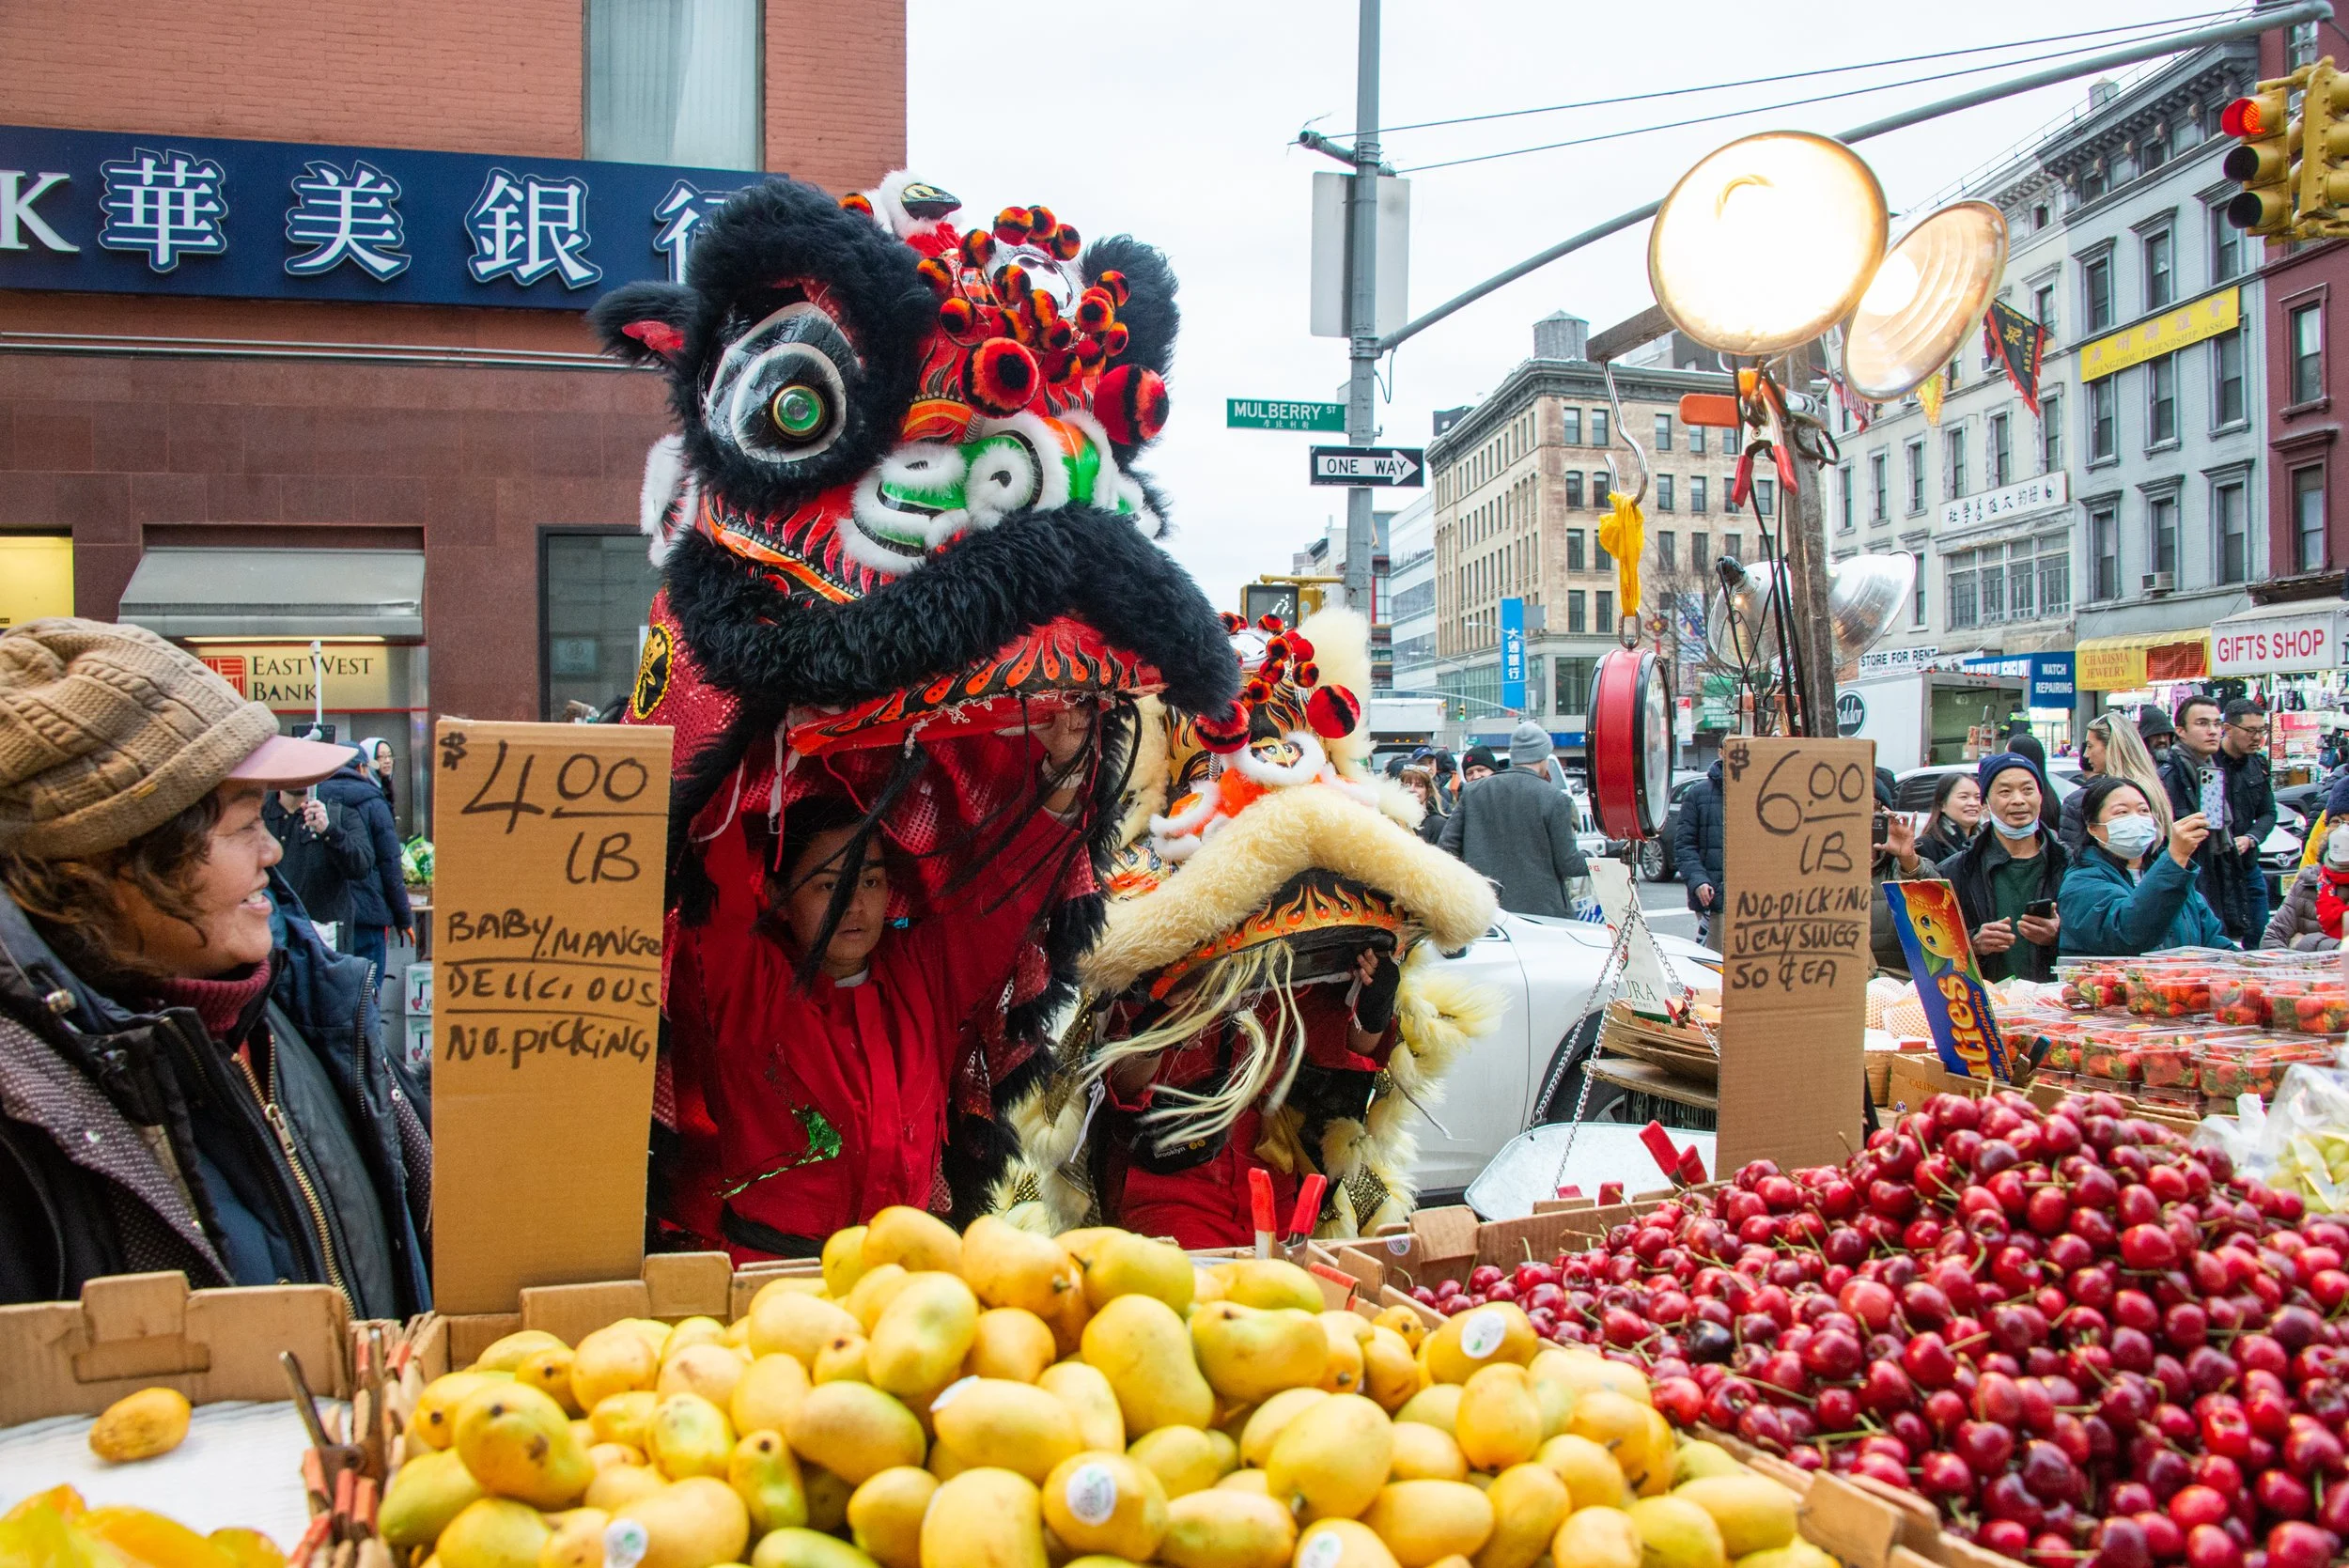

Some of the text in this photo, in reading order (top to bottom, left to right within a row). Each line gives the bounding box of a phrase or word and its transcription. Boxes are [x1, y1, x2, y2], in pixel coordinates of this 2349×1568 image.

[2142, 330, 2199, 358] FRIENDSHIP
[1234, 401, 1336, 421] MULBERRY ST
[1327, 458, 1408, 475] ONE WAY
[2217, 633, 2267, 662] GIFTS
[2272, 629, 2325, 660] SHOP
[1860, 648, 1937, 667] STORE FOR RENT
[2084, 652, 2129, 666] CHARISMA
[2041, 663, 2067, 675] WATCH
[2086, 667, 2125, 678] JEWELRY
[253, 681, 316, 701] BANK
[2035, 681, 2073, 693] REPAIRING
[565, 831, 641, 885] LB
[1799, 831, 1853, 875] LB
[448, 966, 660, 1008] DELICIOUS
[1973, 990, 2001, 1051] MANDARINS
